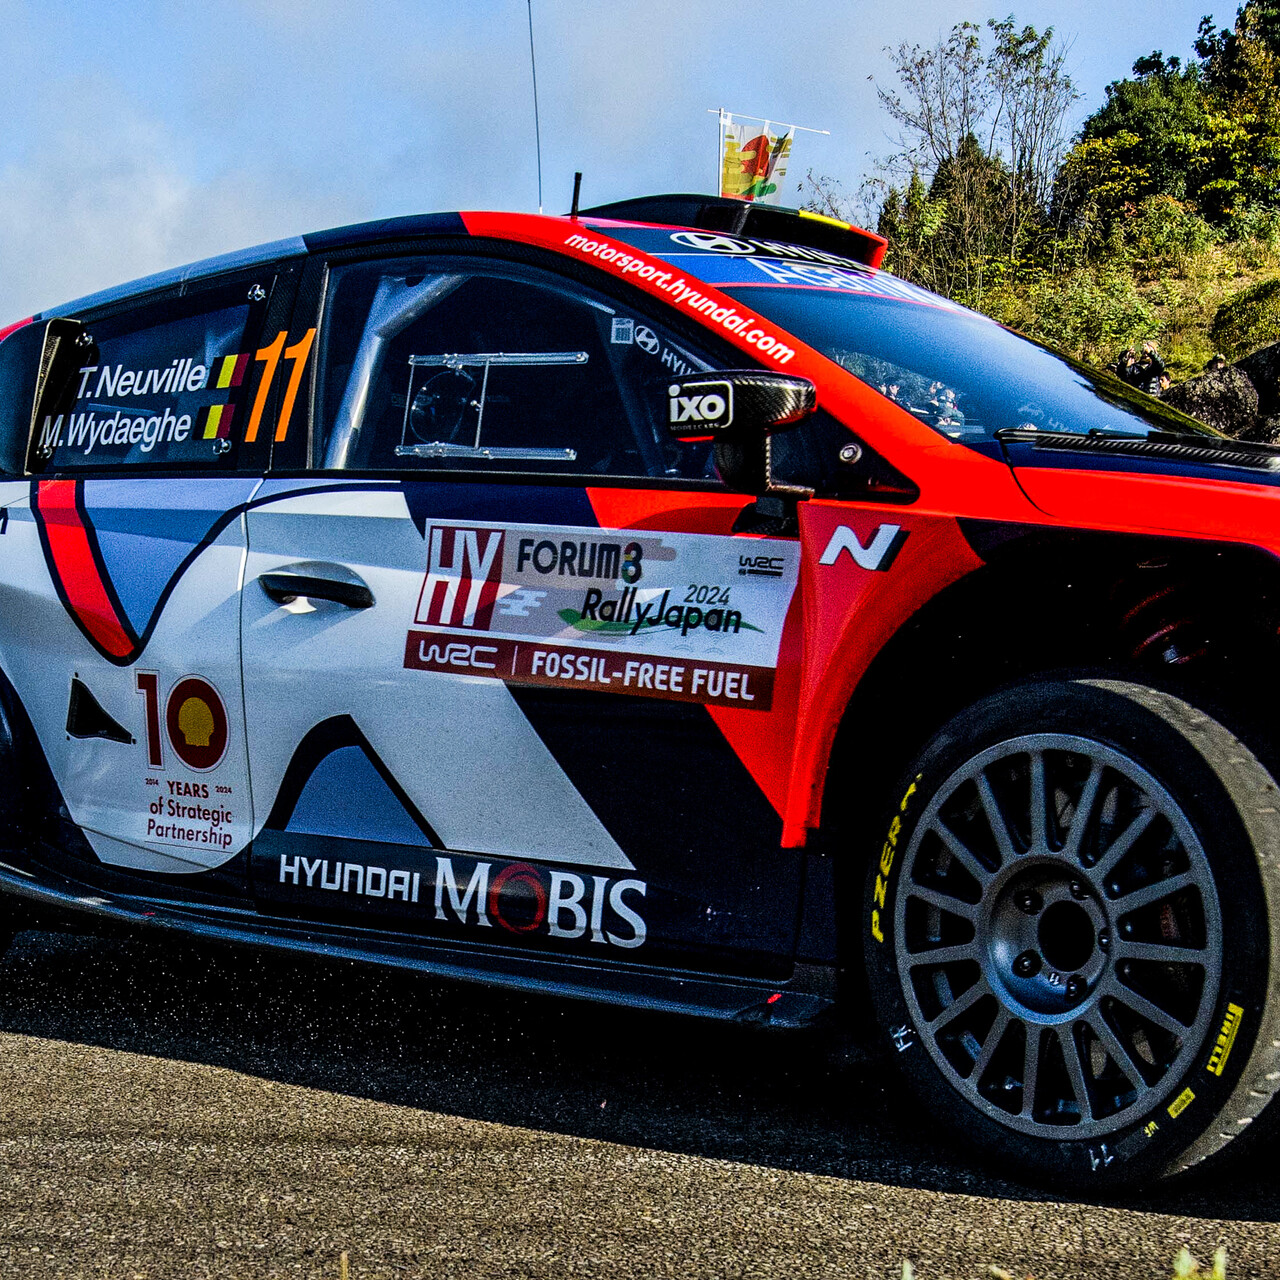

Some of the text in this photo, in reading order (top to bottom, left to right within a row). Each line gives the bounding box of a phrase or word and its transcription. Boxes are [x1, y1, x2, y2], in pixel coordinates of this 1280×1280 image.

[564, 233, 797, 364] motorsport.hyundai.com
[244, 328, 317, 443] 11
[683, 583, 732, 607] 2024
[419, 639, 499, 669] WRC
[531, 650, 755, 701] FOSSIL-FREE FUEL
[166, 780, 210, 799] YEARS
[149, 796, 233, 828] of Strategic
[146, 817, 233, 849] Partnership
[279, 853, 421, 903] HYUNDAI
[433, 856, 648, 949] MOBIS
